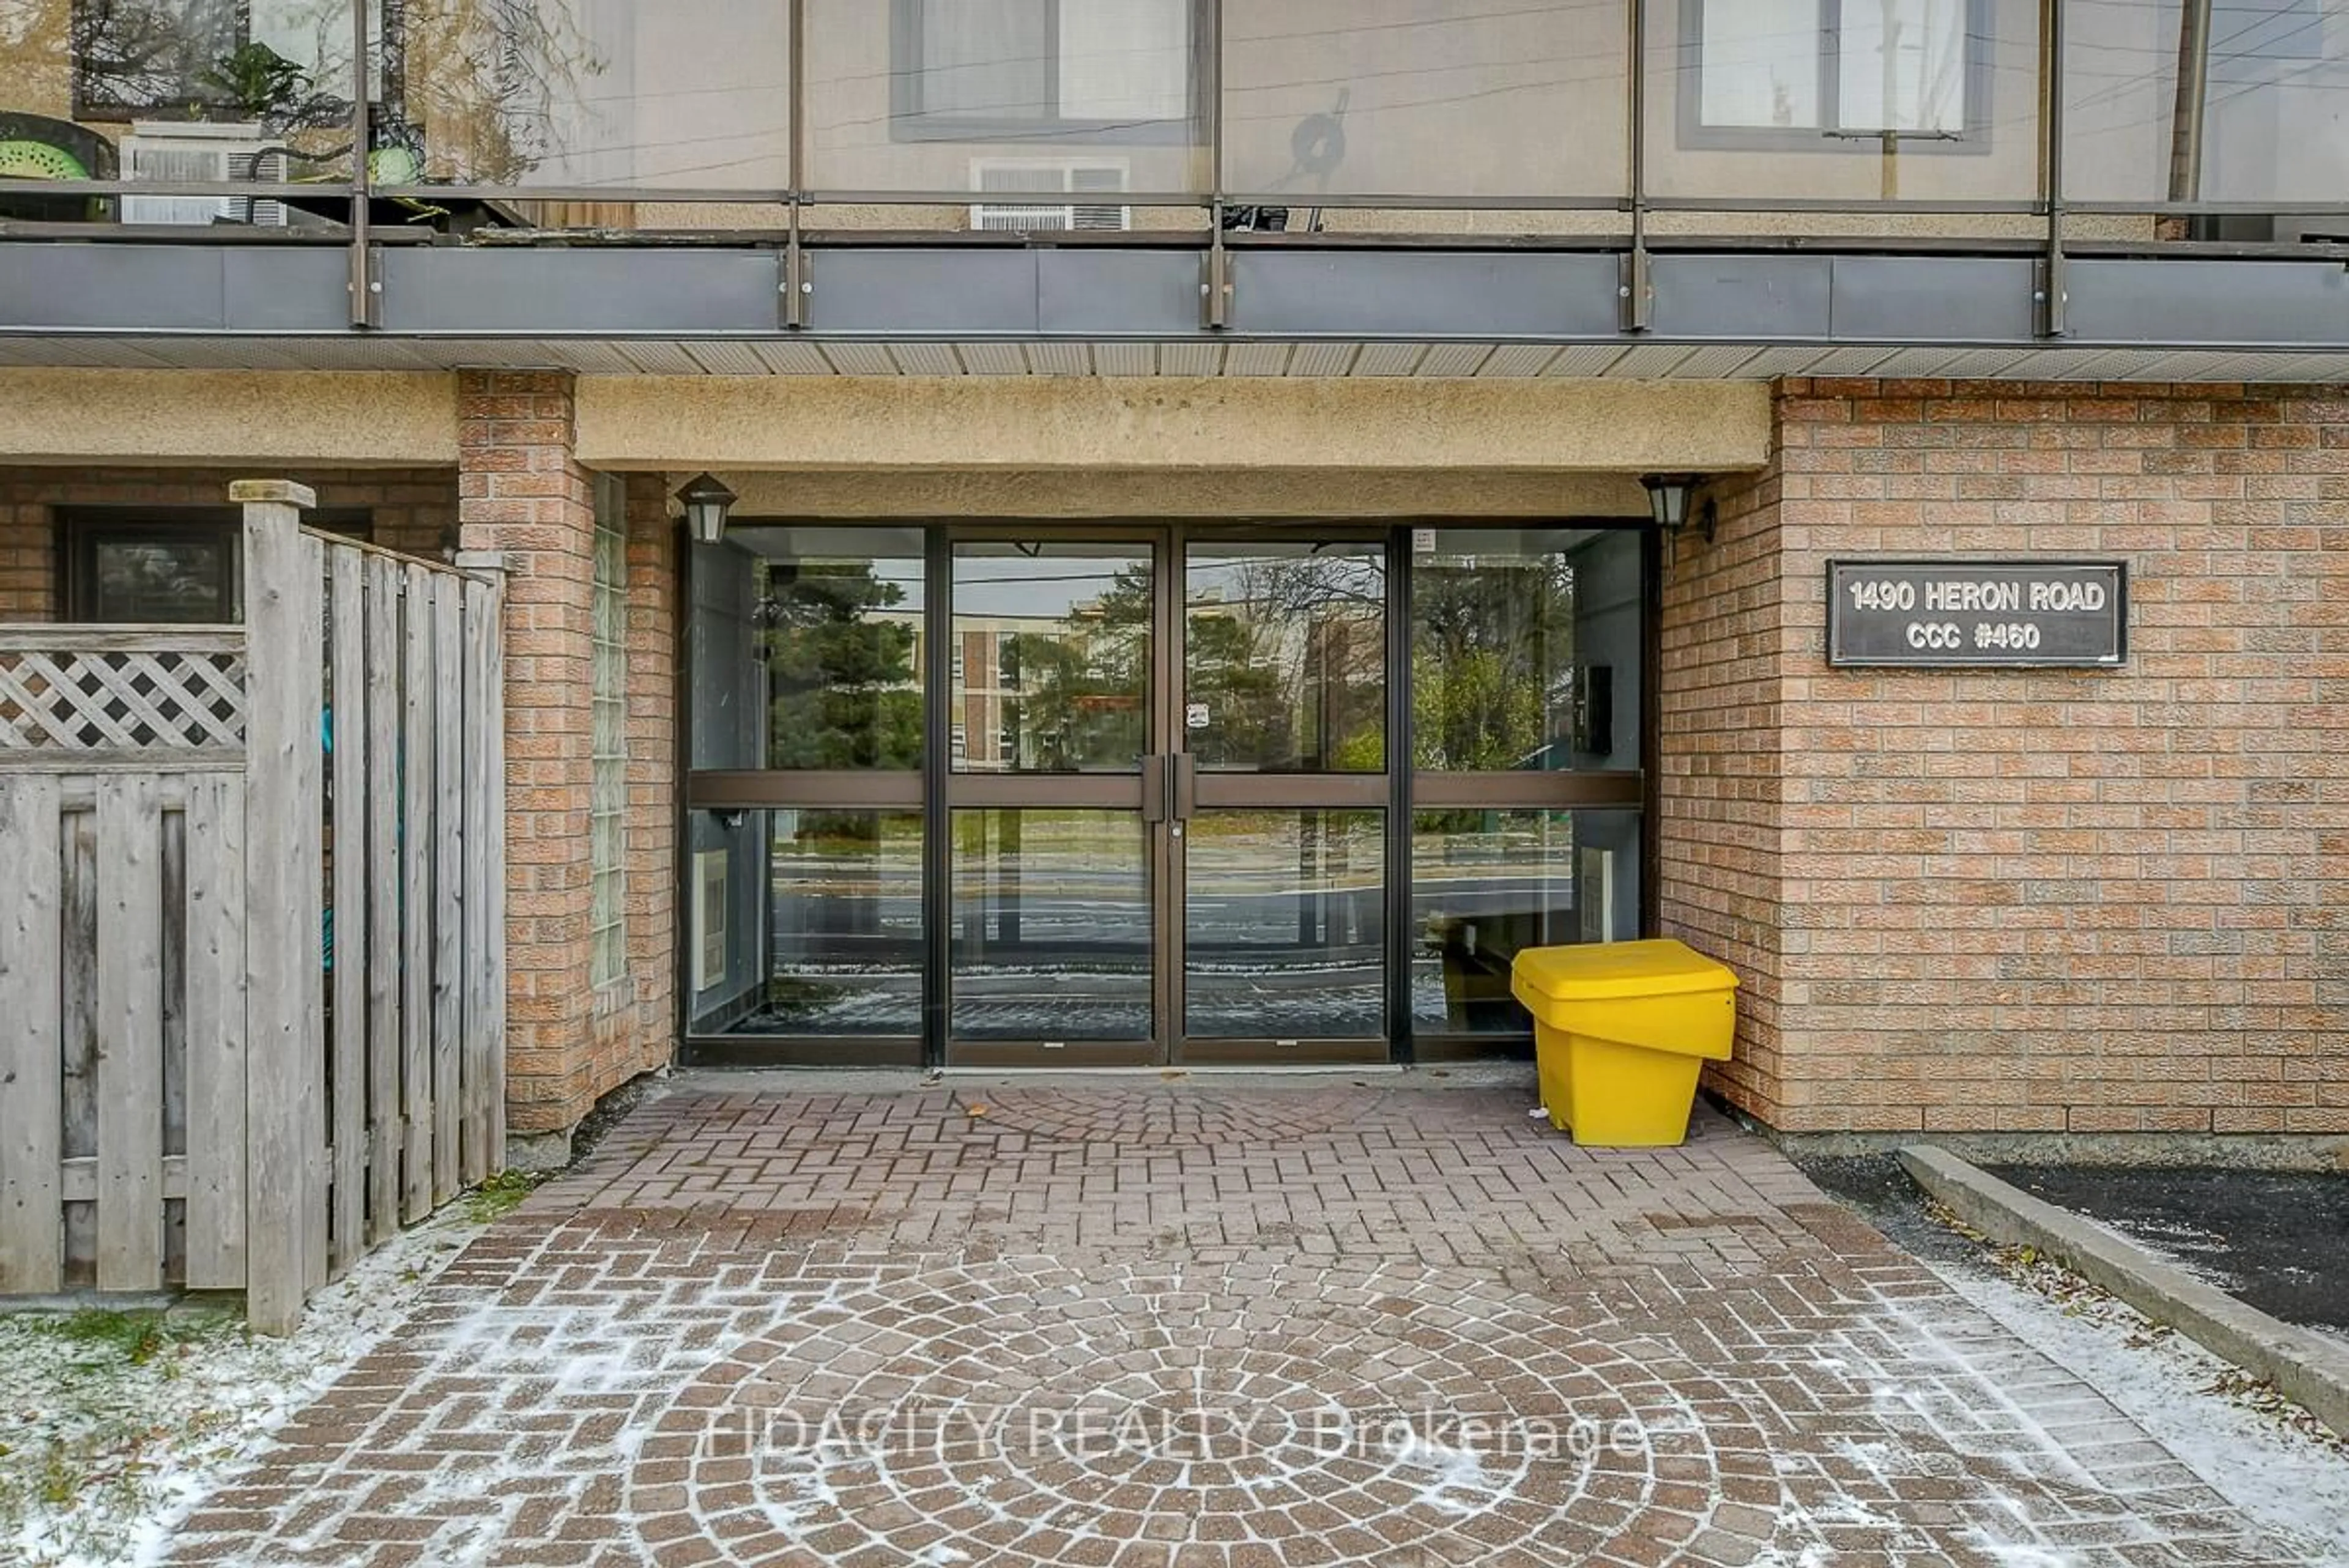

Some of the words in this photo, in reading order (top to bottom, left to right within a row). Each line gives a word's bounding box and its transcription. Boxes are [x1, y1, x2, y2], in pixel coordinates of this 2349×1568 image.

[1850, 581, 1915, 611] 1490
[1924, 582, 2019, 611] HERON
[2029, 582, 2106, 611] ROAD
[1906, 621, 1962, 649] CCC
